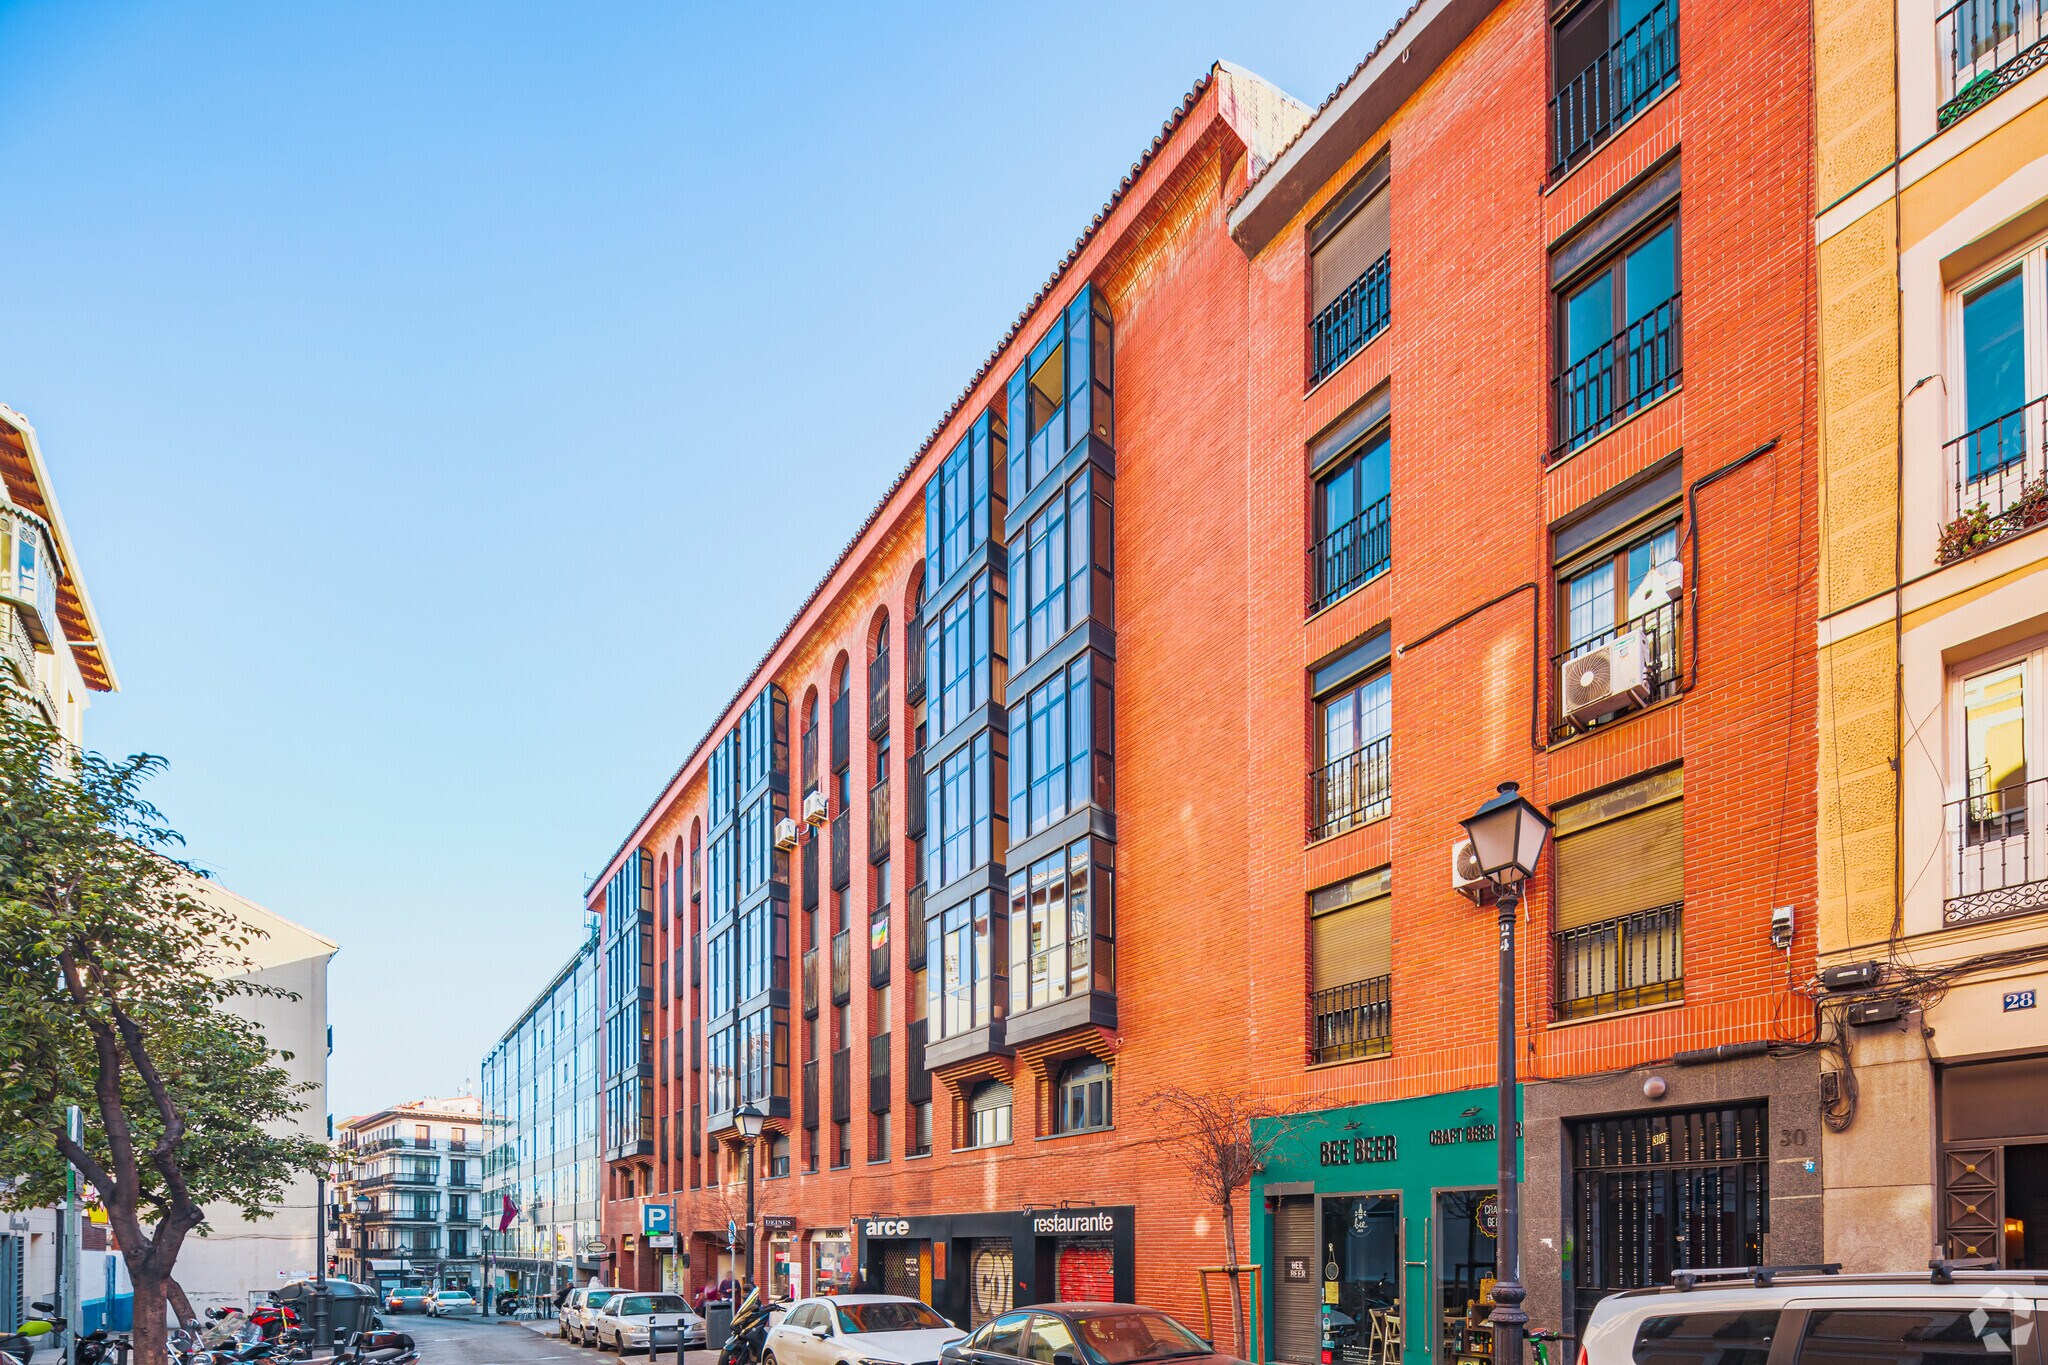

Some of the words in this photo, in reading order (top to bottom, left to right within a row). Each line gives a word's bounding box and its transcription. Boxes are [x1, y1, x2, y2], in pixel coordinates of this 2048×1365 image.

[2006, 992, 2033, 1010] 28
[1429, 1127, 1463, 1146] CRAFT
[1465, 1124, 1496, 1142] BEER
[1653, 1133, 1665, 1145] 30
[1779, 1128, 1807, 1147] 30
[1320, 1139, 1351, 1166] BEE
[1353, 1134, 1398, 1163] BEER
[648, 1208, 667, 1228] P
[1484, 1205, 1498, 1215] CRA
[866, 1220, 910, 1236] arce
[1034, 1212, 1114, 1233] restaurante
[1290, 1269, 1306, 1279] BEER
[1291, 1261, 1303, 1270] BEE
